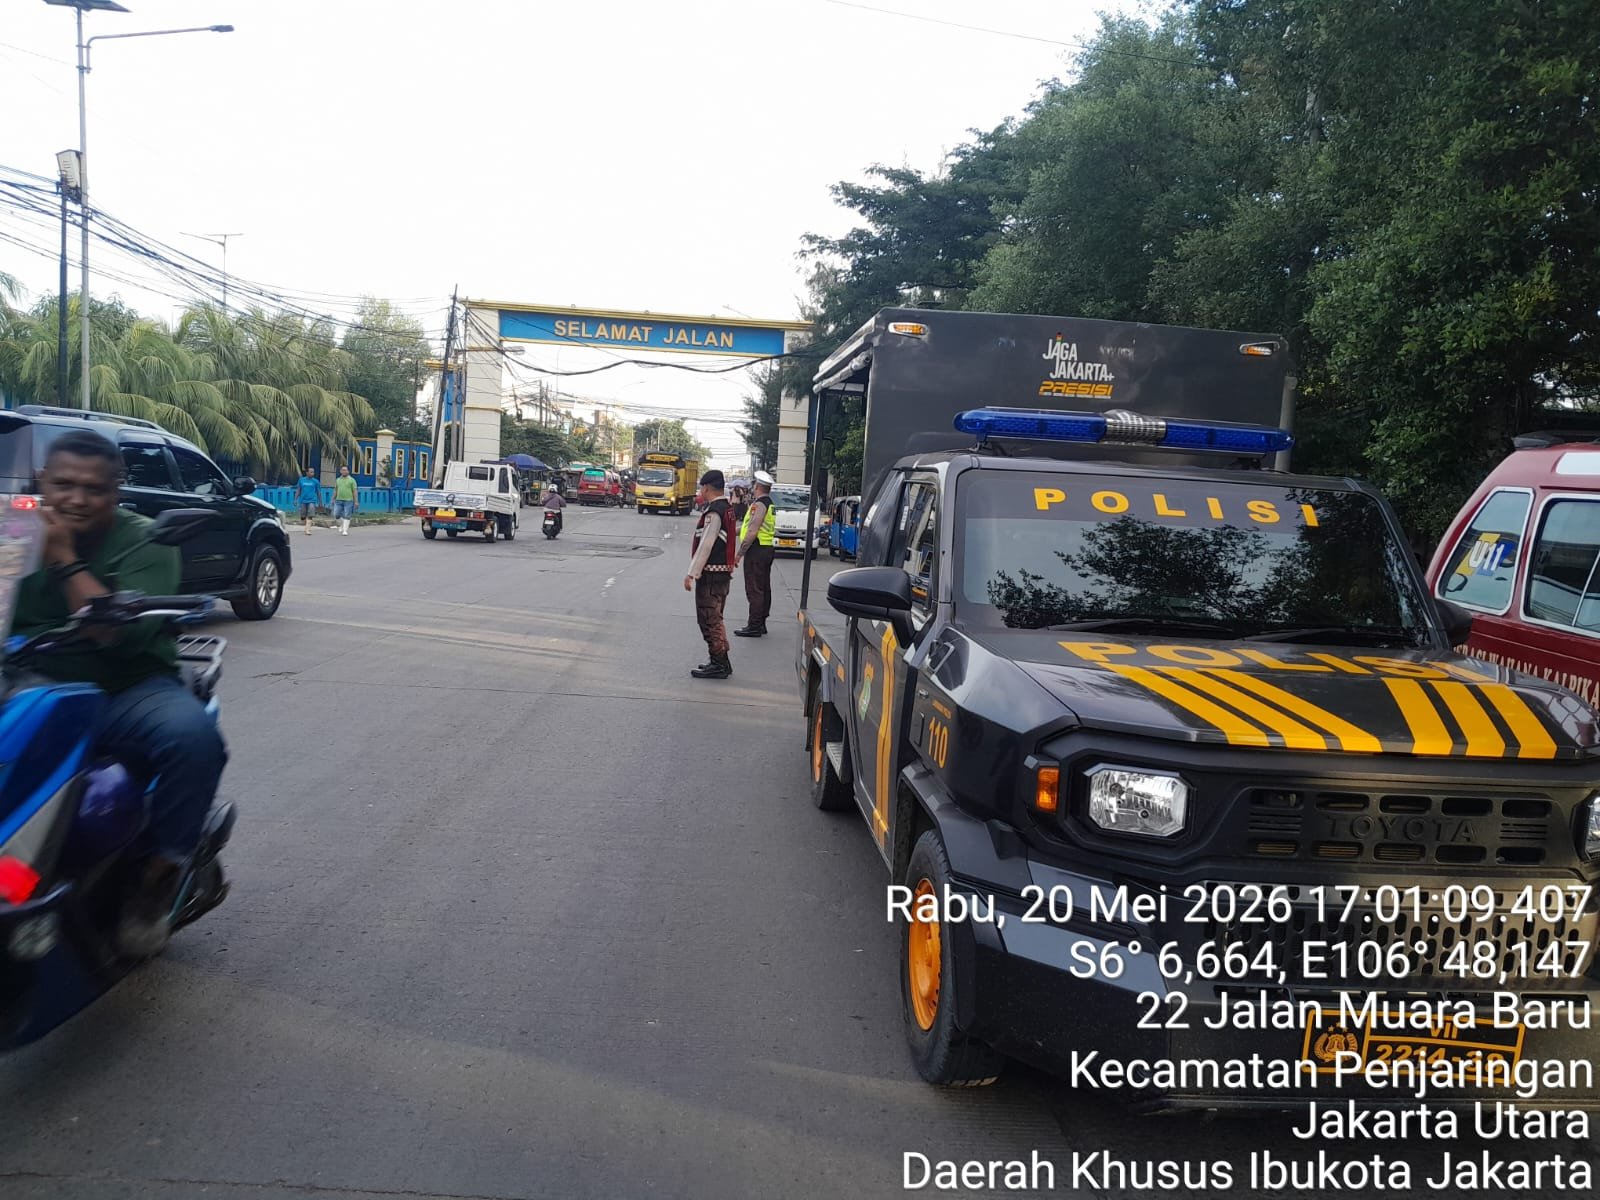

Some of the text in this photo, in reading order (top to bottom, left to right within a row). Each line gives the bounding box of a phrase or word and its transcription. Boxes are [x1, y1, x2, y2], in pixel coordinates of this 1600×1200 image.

[554, 320, 734, 348] SELAMAT JALAN
[1042, 338, 1078, 361] JAGA
[1039, 380, 1113, 396] PRESISI
[1033, 487, 1319, 527] POLISI
[1469, 540, 1506, 571] U11
[1057, 641, 1494, 684] POLISI
[1543, 667, 1600, 711] KALPIKA
[928, 716, 949, 769] 110
[1324, 814, 1478, 842] TOYOTA
